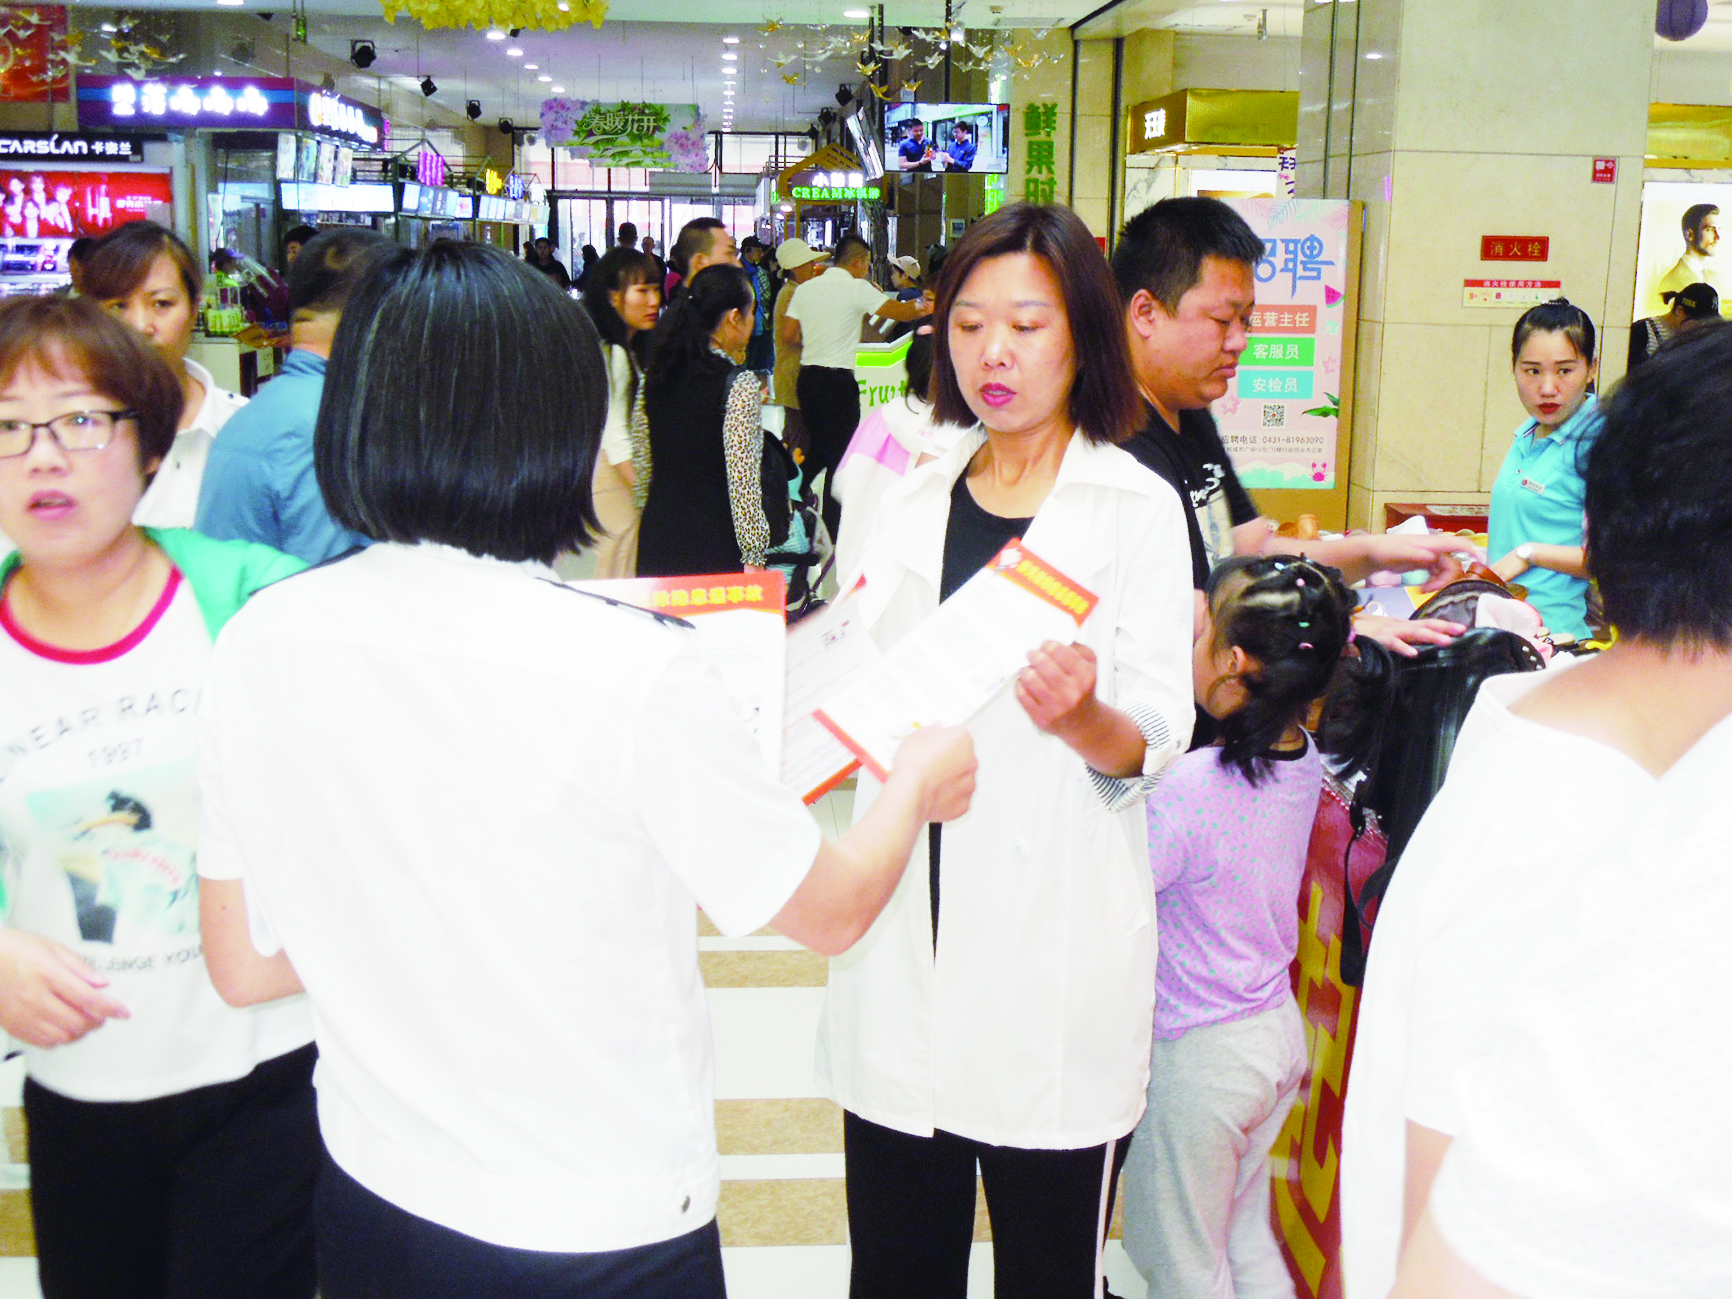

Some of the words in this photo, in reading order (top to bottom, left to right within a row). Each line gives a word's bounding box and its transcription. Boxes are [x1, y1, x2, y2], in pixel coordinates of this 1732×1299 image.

[91, 141, 132, 155] 卡姿兰
[1490, 241, 1541, 256] 消火栓
[1249, 312, 1310, 327] 运营主任
[1253, 344, 1299, 359] 客服员
[1252, 377, 1298, 393] 安检员
